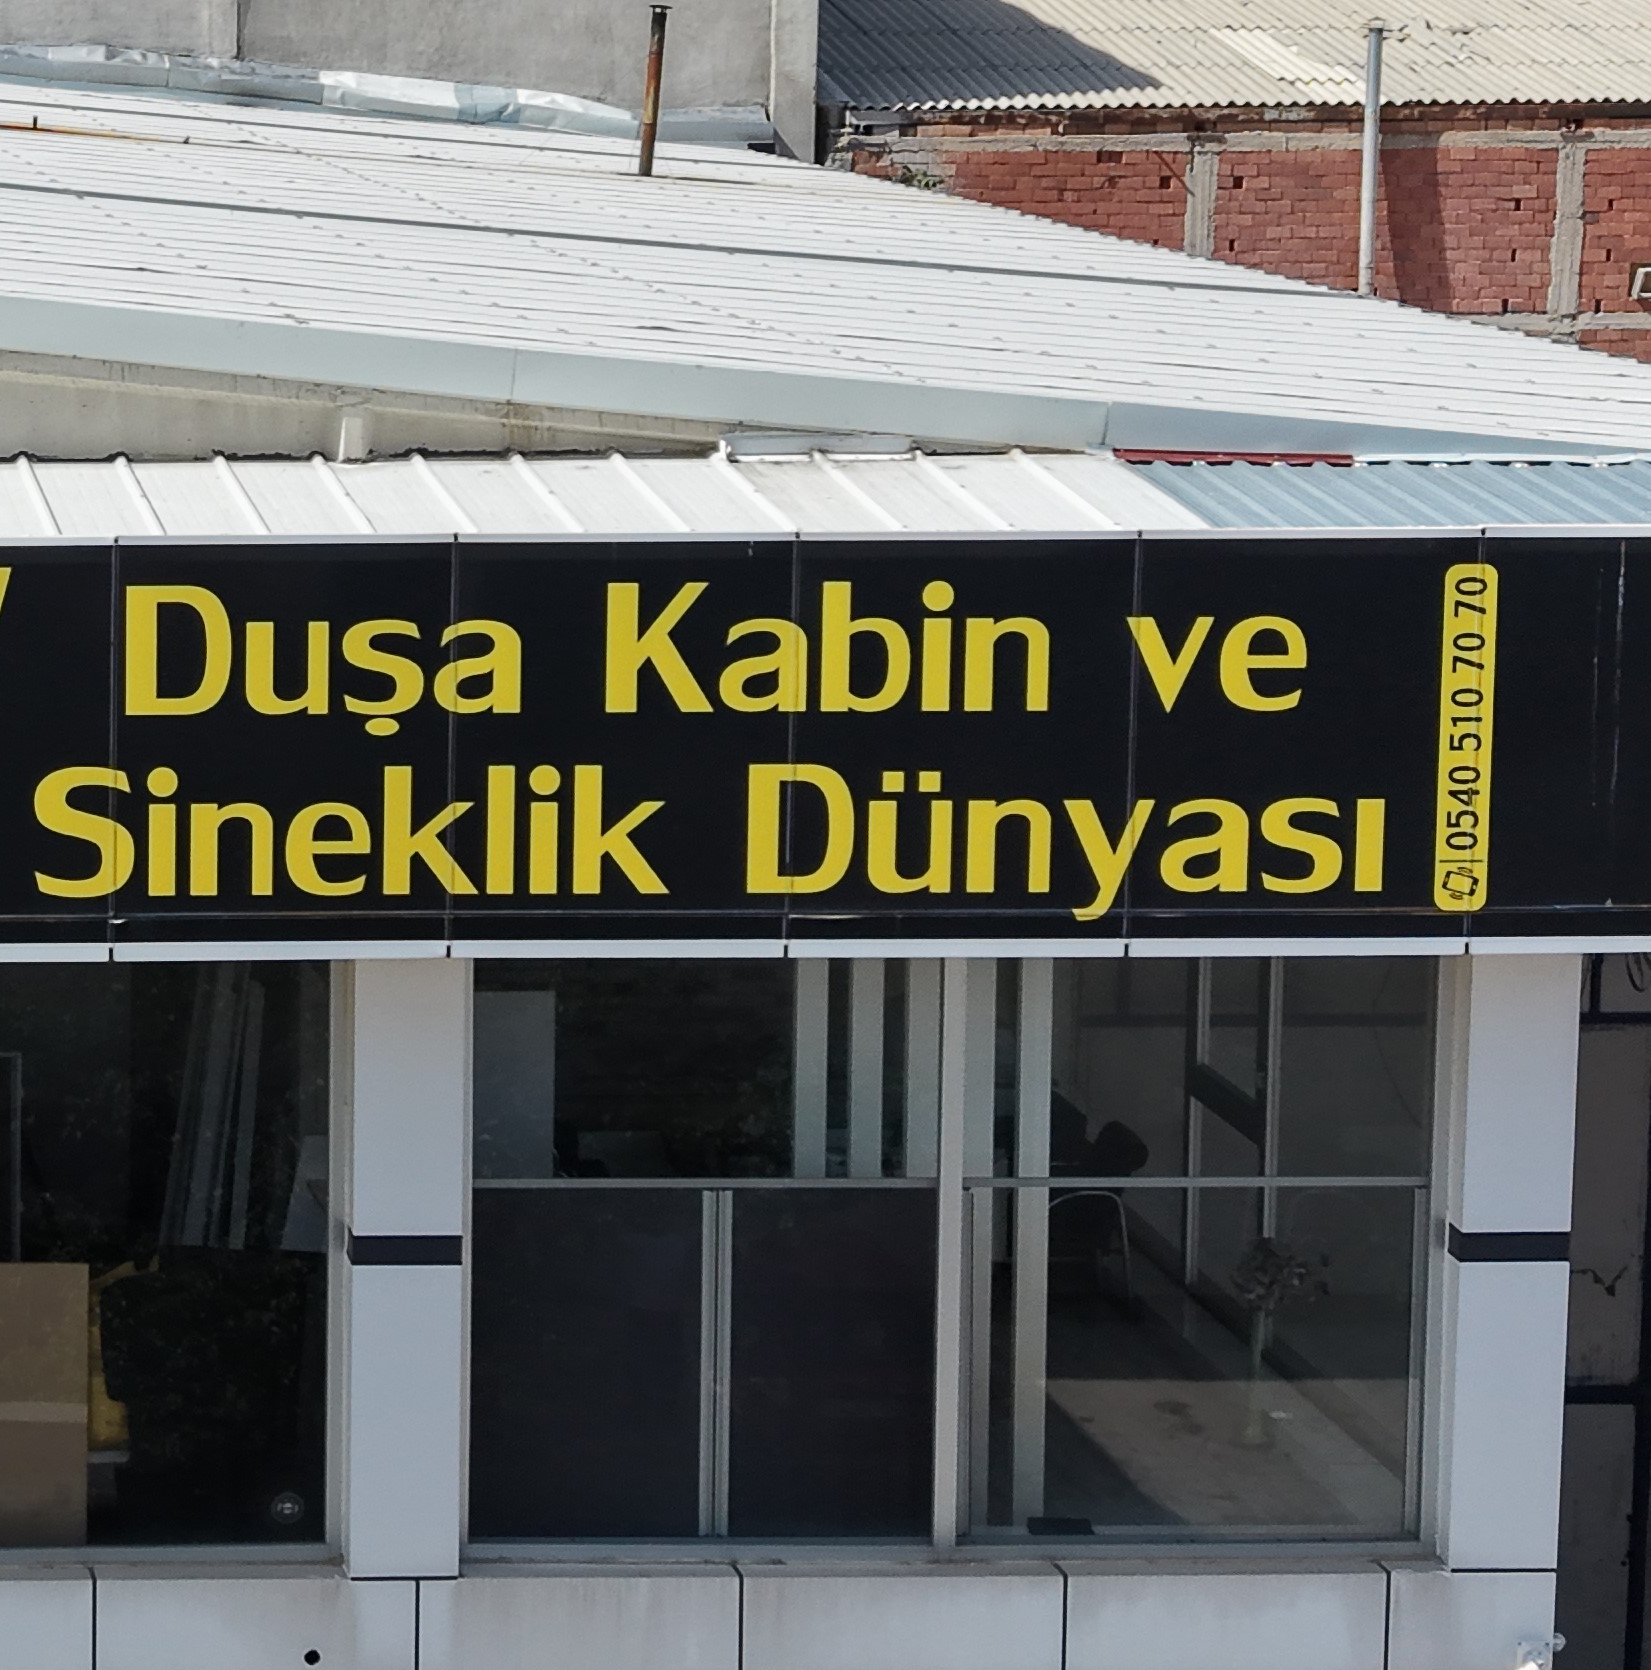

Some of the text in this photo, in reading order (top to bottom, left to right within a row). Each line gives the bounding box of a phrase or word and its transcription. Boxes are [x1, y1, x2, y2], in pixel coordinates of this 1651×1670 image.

[122, 579, 1308, 737] Duşa Kabin ve
[1445, 576, 1488, 851] 0540 510 70 70
[32, 761, 1386, 922] Sineklik Dünyası
